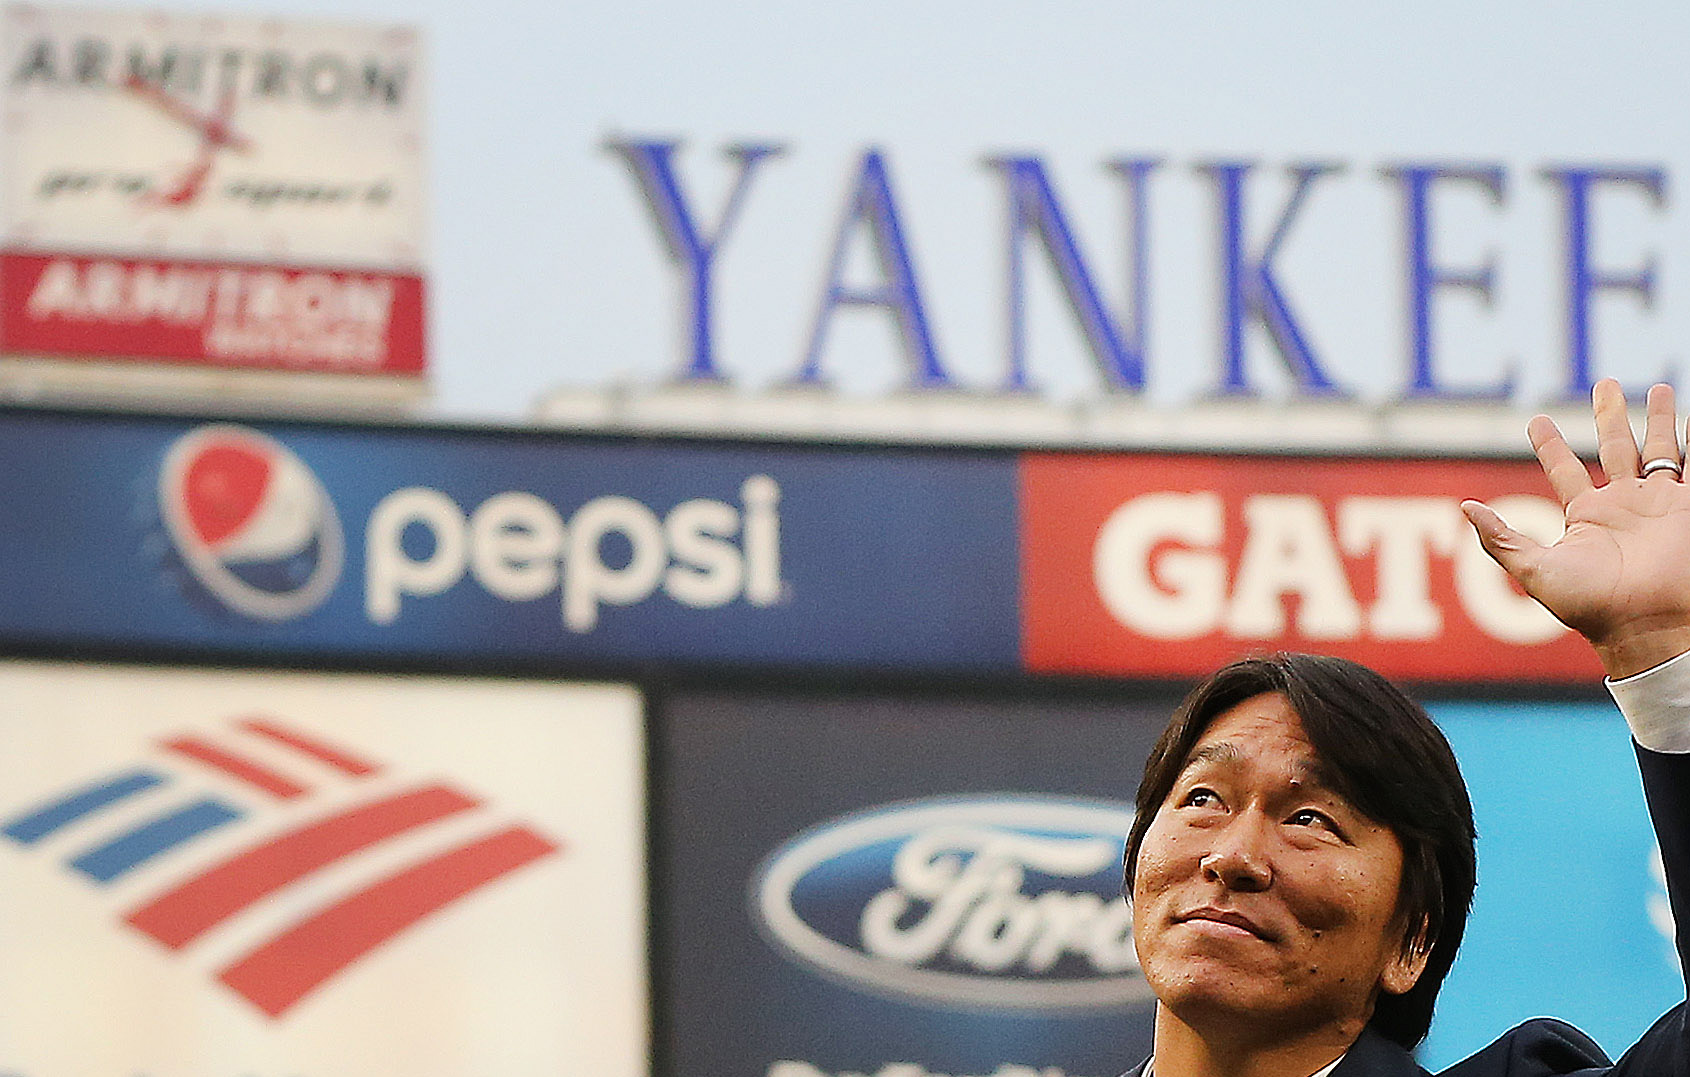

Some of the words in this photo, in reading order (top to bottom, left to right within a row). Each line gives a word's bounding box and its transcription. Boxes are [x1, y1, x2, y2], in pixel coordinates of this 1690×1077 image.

[12, 40, 408, 106] ARMITRON
[602, 136, 1686, 404] YANKEE
[364, 476, 784, 634] pepsi
